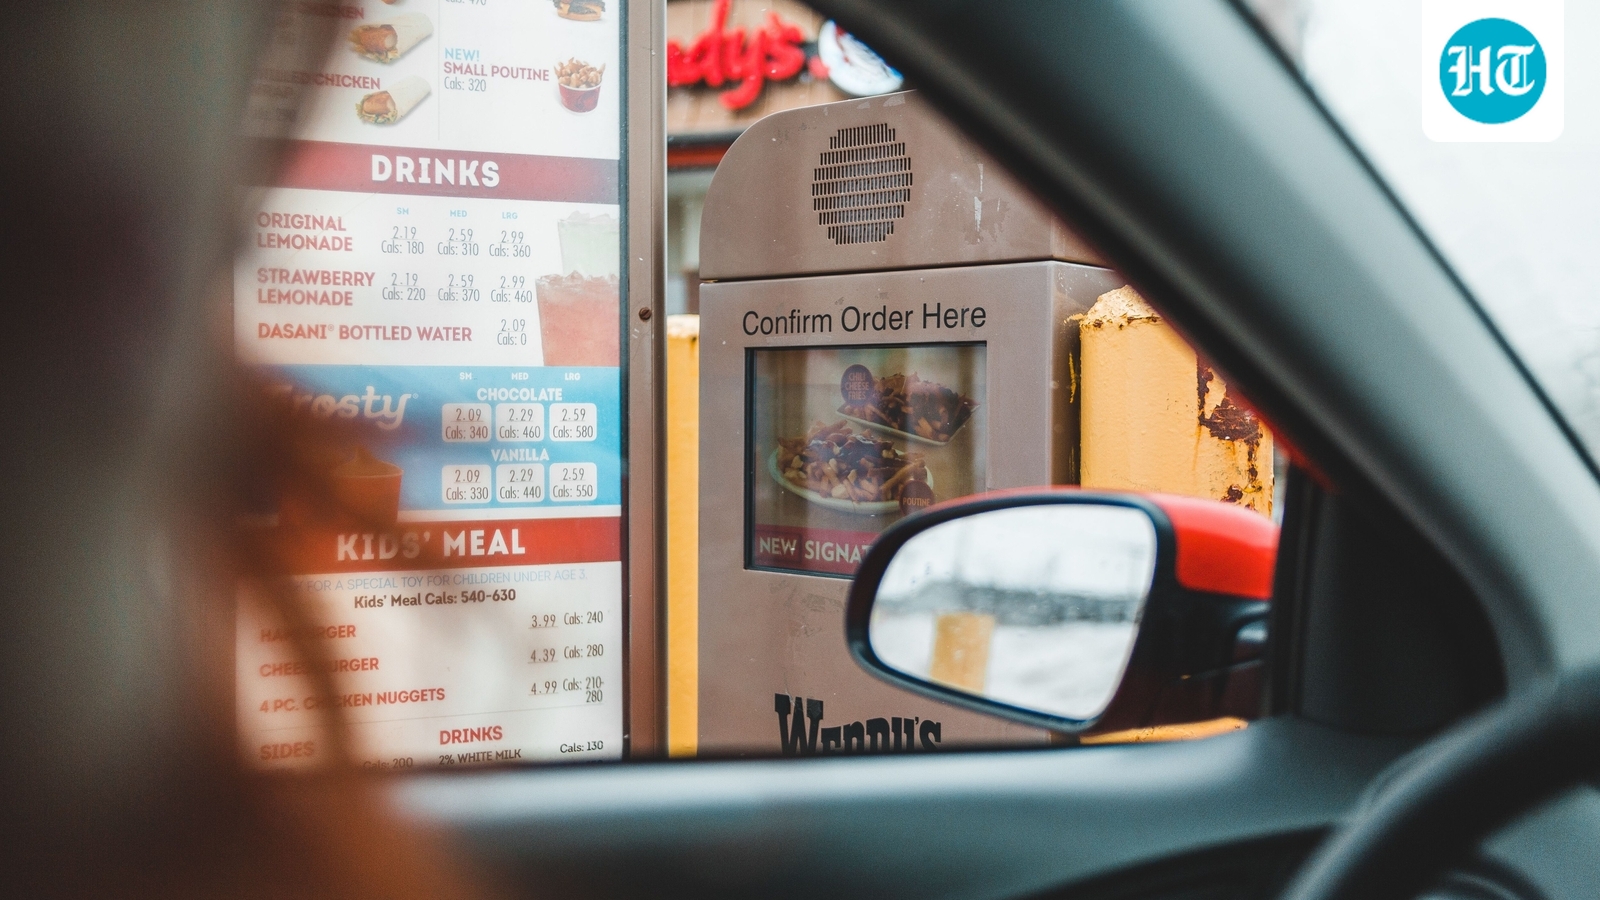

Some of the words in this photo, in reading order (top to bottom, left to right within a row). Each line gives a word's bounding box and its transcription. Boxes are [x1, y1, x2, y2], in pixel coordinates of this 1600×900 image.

[444, 47, 480, 62] NEW!
[443, 61, 488, 77] SMALL
[491, 65, 549, 81] POUTINE
[314, 73, 380, 90] CHICKEN
[444, 76, 465, 90] Cals:
[468, 78, 486, 92] 320
[371, 154, 500, 188] DRINKS
[396, 207, 409, 215] SM
[450, 209, 468, 217] MED
[501, 212, 518, 220] LRG
[257, 211, 347, 231] ORIGINAL
[393, 226, 417, 240] 2.19
[449, 228, 473, 242] 2.59
[501, 230, 524, 244] 2.99
[257, 232, 353, 252] LEMONADE
[381, 240, 403, 254] Cals:
[407, 241, 424, 254] 180
[437, 242, 458, 255] Cals:
[461, 243, 479, 256] 310
[489, 243, 510, 257] Cals:
[512, 245, 531, 258] 360
[257, 267, 375, 287] STRAWBERRY
[391, 272, 418, 286] 2.19
[448, 274, 474, 288] 2.59
[500, 275, 525, 289] 2.99
[257, 287, 353, 306] LEMONADE
[382, 287, 403, 301] Cals:
[407, 288, 425, 301] 220
[438, 288, 459, 301] Cals:
[462, 289, 480, 302] 370
[490, 289, 511, 302] Cals:
[514, 290, 533, 303] 460
[500, 318, 526, 332] 2.09
[742, 309, 832, 336] Confirm
[841, 305, 914, 332] Order
[922, 302, 987, 329] Here
[339, 324, 412, 341] BOTTLED
[416, 326, 472, 342] WATER
[497, 332, 517, 346] Cals:
[520, 333, 527, 346] 0
[459, 372, 472, 380] SM
[511, 372, 529, 380] MED
[564, 372, 581, 381] LRG
[848, 371, 866, 382] CHILI
[845, 381, 870, 391] CHEESE
[476, 387, 563, 401] CHOCOLATE
[847, 391, 866, 401] FRIES
[456, 408, 482, 421] 2.09
[508, 408, 534, 422] 2.29
[561, 408, 586, 421] 2.59
[445, 426, 466, 439] Cals:
[469, 426, 488, 439] 340
[499, 425, 519, 439] Cals:
[522, 426, 541, 438] 460
[552, 425, 572, 438] Cals:
[576, 425, 594, 438] 580
[491, 448, 550, 462] VANILLA
[454, 469, 480, 483] 2.09
[509, 468, 534, 482] 2.29
[562, 467, 585, 481] 2.59
[446, 487, 467, 500] Cals:
[470, 487, 488, 500] 330
[499, 486, 520, 499] Cals:
[523, 486, 541, 498] 440
[552, 485, 572, 498] Cals:
[576, 484, 593, 497] 550
[902, 497, 931, 507] POUTINE
[337, 531, 431, 561] KIDS'
[443, 528, 526, 557] MEAL
[759, 537, 797, 555] NEW
[307, 579, 332, 592] FOR
[335, 580, 344, 590] A
[347, 577, 398, 590] SPECIAL
[401, 575, 424, 588] TOY
[427, 575, 450, 587] FOR
[453, 572, 511, 586] CHILDREN
[513, 570, 550, 583] UNDER
[554, 569, 576, 581] AGE
[579, 569, 588, 580] 3.
[354, 595, 387, 609] Kids'
[390, 593, 422, 607] Meal
[425, 591, 458, 606] Cals:
[461, 588, 516, 603] 540-630
[531, 614, 556, 628] 3.99
[564, 612, 583, 626] Cals:
[586, 611, 603, 624] 240
[530, 648, 556, 662] 4.39
[563, 645, 583, 659] Cals:
[587, 644, 604, 657] 280
[531, 681, 557, 695] 4.99
[563, 678, 582, 692] Cals:
[585, 676, 605, 690] 210-
[259, 700, 269, 713] 4
[273, 699, 299, 712] PC.
[376, 688, 445, 705] NUGGETS
[586, 690, 603, 703] 280
[439, 725, 503, 746] DRINKS
[260, 741, 314, 761] SIDES
[560, 743, 584, 754] Cals:
[587, 740, 604, 751] 130
[363, 759, 390, 771] Cals:
[392, 757, 413, 769] 200
[438, 754, 455, 766] 2%
[457, 751, 493, 764] WHITE
[495, 749, 522, 761] MILK
